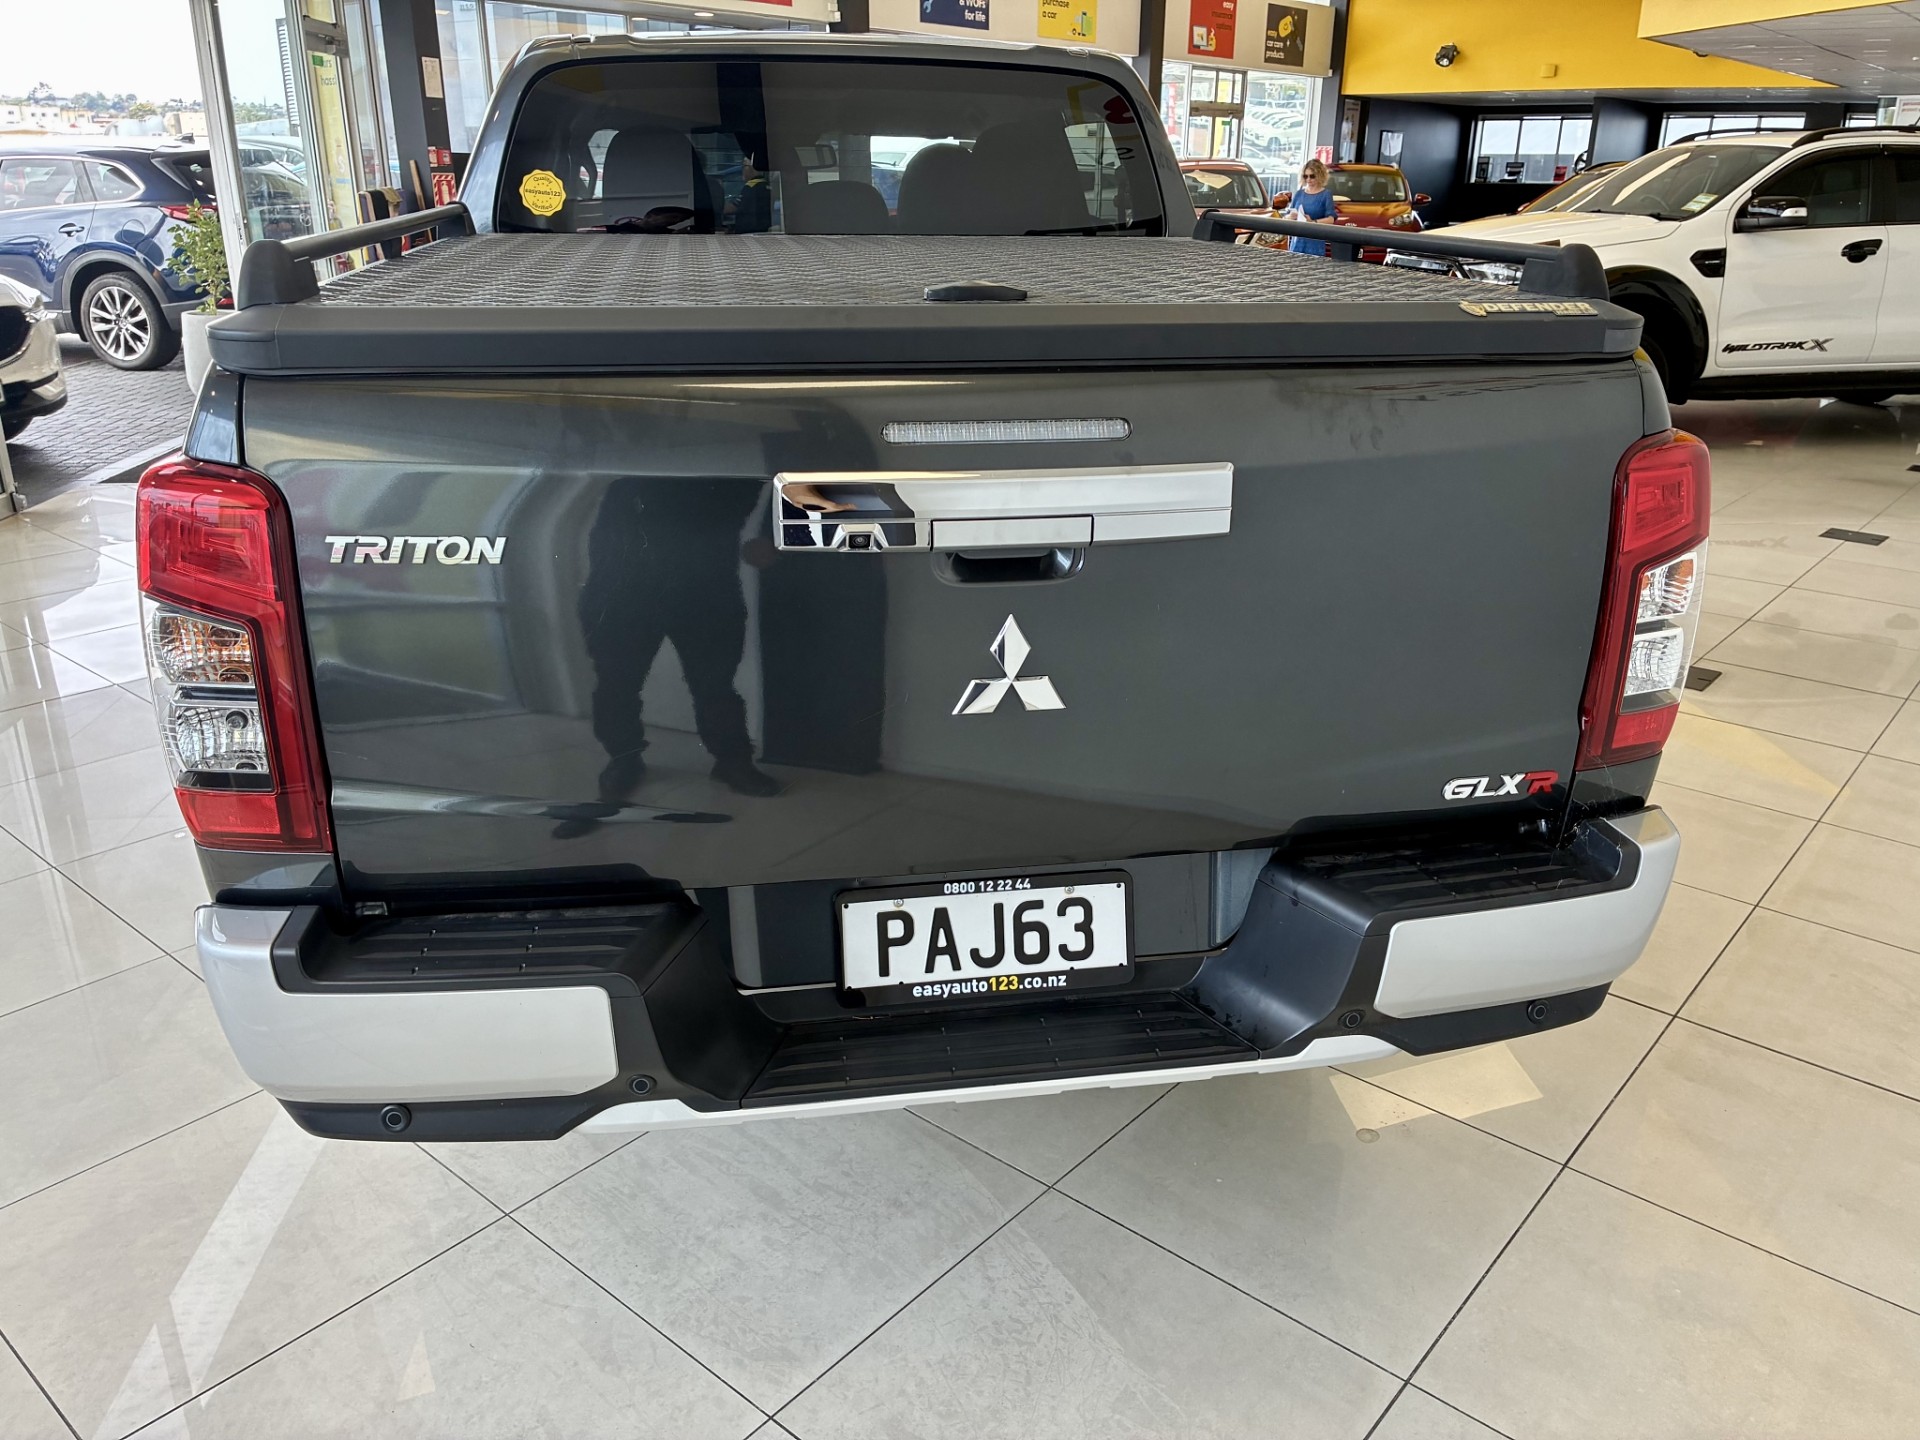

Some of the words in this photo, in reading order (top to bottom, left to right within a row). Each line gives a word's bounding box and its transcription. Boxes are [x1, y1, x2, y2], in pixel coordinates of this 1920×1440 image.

[964, 9, 975, 21] for
[975, 11, 986, 22] life
[1047, 11, 1057, 19] car
[532, 176, 553, 184] Quality
[524, 188, 561, 197] easyauto123
[532, 201, 553, 210] Verified
[1482, 302, 1595, 314] DEFENDER
[324, 535, 507, 565] TRITON
[943, 881, 976, 895] 0800
[978, 880, 993, 893] 12
[996, 879, 1013, 892] 22
[1015, 878, 1031, 891] 44
[876, 896, 1094, 978] PAJ63
[912, 974, 1067, 999] easyauto123.co.nz
